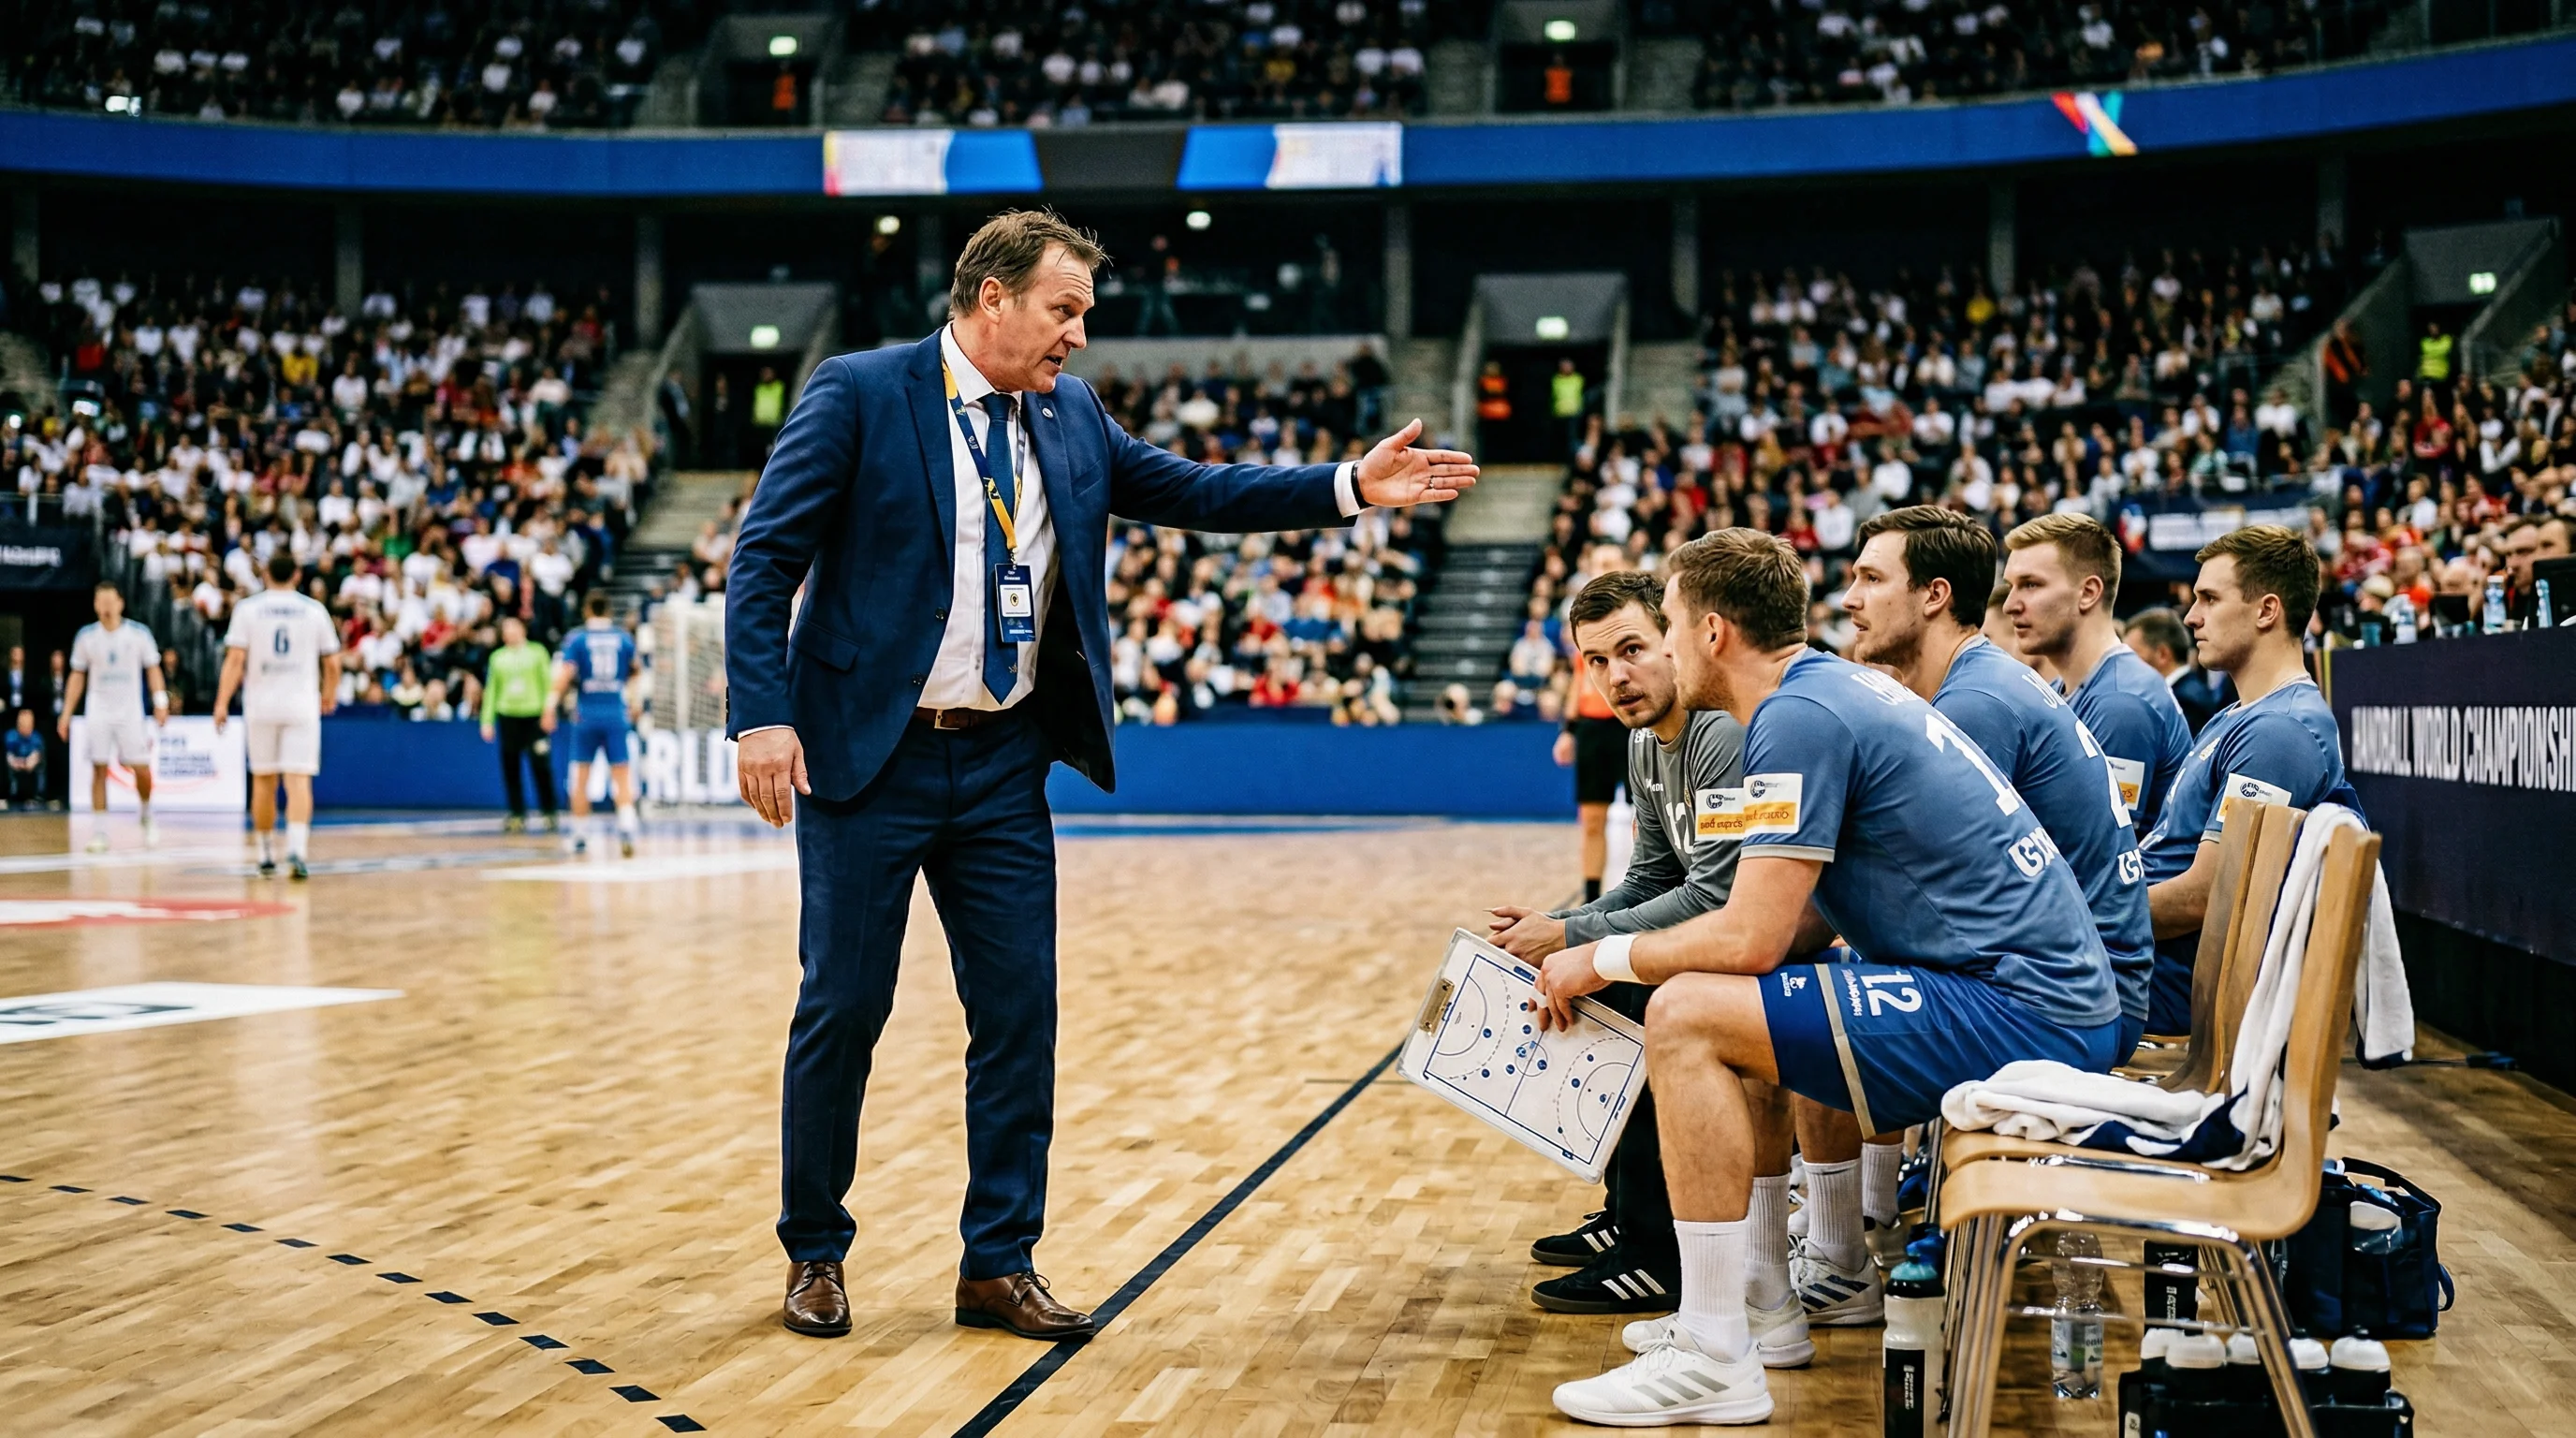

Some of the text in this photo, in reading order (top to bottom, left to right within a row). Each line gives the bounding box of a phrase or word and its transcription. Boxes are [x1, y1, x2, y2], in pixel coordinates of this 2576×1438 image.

[273, 624, 290, 656] 6
[2412, 706, 2460, 781] WORLD
[1860, 971, 1922, 1017] 12
